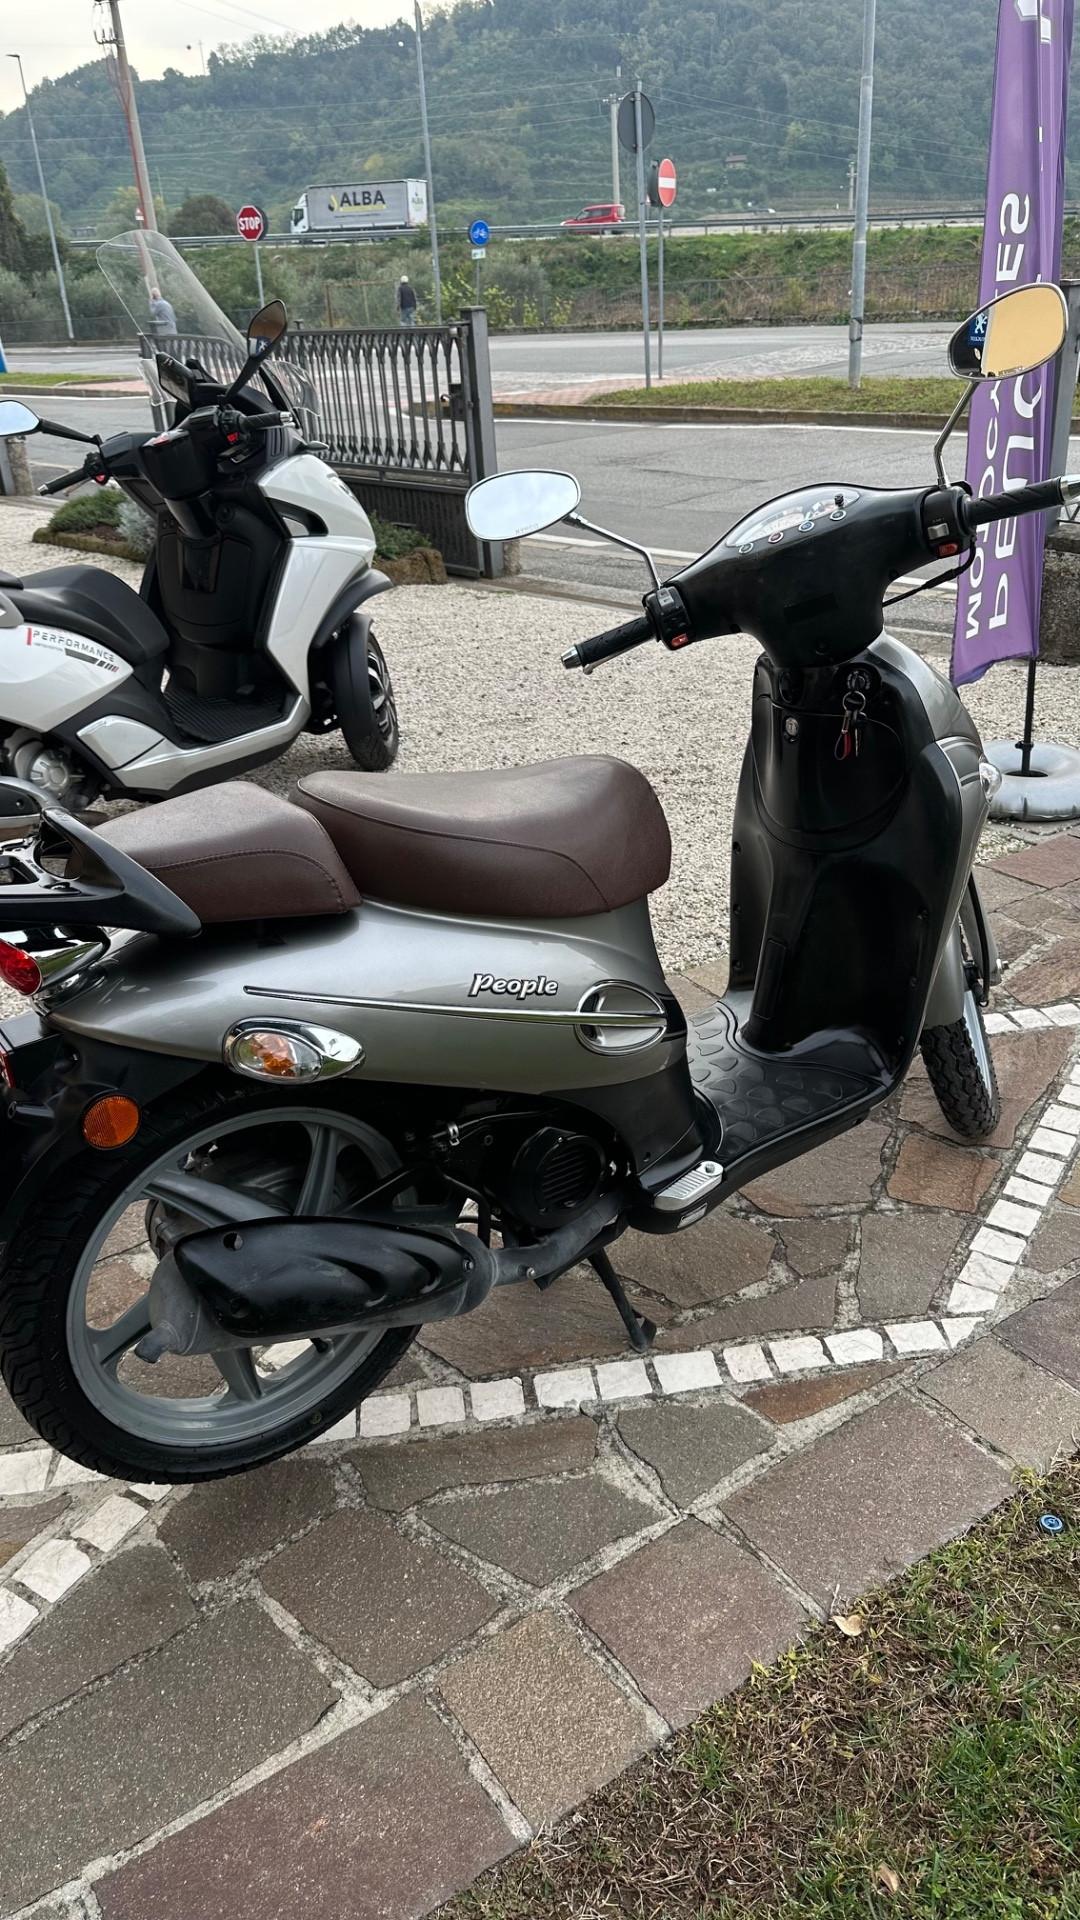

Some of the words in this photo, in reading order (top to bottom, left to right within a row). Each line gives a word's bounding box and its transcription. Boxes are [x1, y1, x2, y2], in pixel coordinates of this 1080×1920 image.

[340, 190, 386, 207] ALBA
[239, 216, 260, 230] STOP
[33, 629, 116, 662] PERFORMANCE
[468, 973, 558, 1000] People
